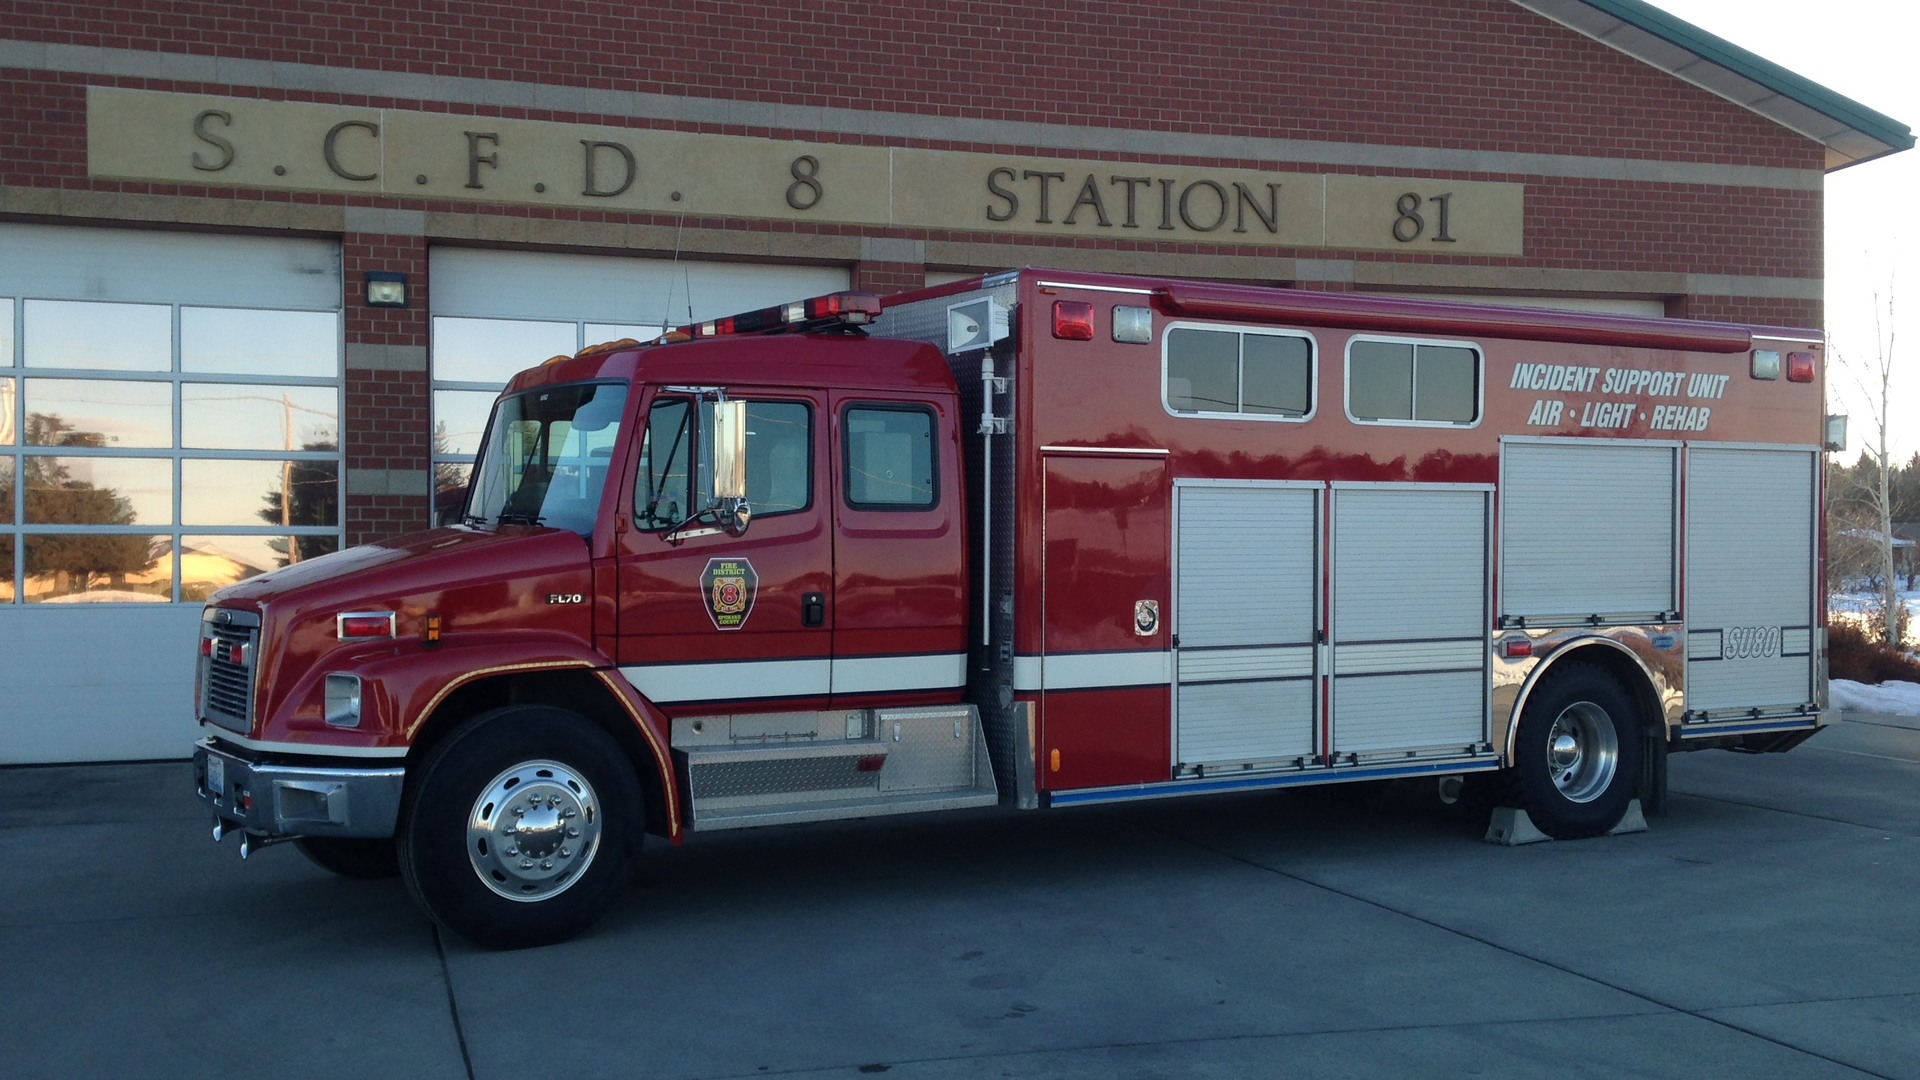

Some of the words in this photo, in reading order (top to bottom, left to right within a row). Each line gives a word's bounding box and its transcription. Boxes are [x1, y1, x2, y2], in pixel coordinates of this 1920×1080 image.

[786, 154, 823, 211] 8
[986, 166, 1282, 235] STATION
[1392, 191, 1457, 243] 81
[1510, 362, 1600, 392] INCIDENT
[1601, 367, 1686, 397] SUPPORT
[1687, 372, 1730, 399] UNIT
[1527, 399, 1564, 426] AIR
[1580, 401, 1637, 429] LIGHT
[1650, 404, 1711, 431] REHAB
[712, 568, 746, 576] DISTRICT
[550, 594, 582, 604] FL70
[722, 584, 738, 605] 8
[1725, 626, 1780, 660] SU80
